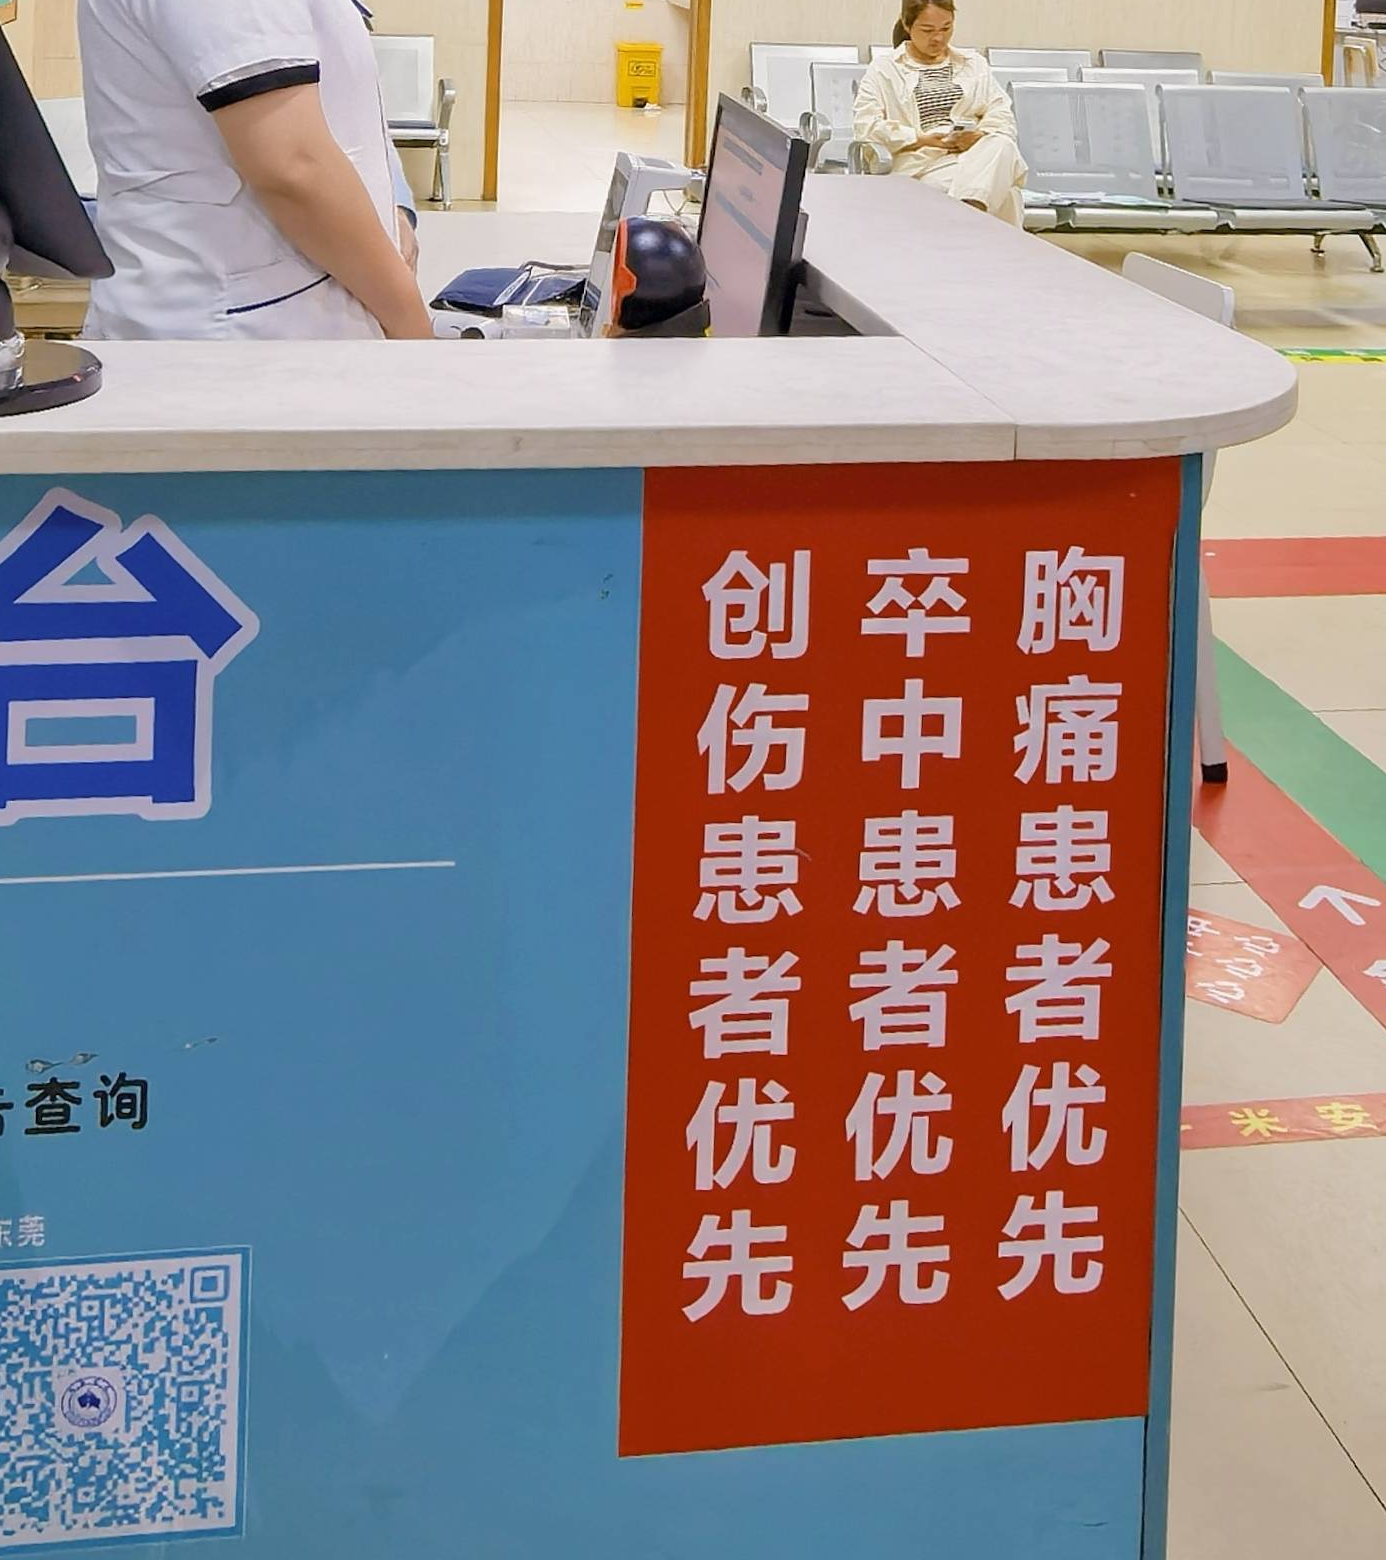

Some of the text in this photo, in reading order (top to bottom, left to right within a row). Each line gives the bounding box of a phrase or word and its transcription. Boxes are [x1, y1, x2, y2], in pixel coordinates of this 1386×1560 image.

[682, 548, 812, 1324] 创伤患者优先
[841, 546, 971, 1313] 卒中患者优先
[997, 544, 1126, 1304] 胸痛患者优先
